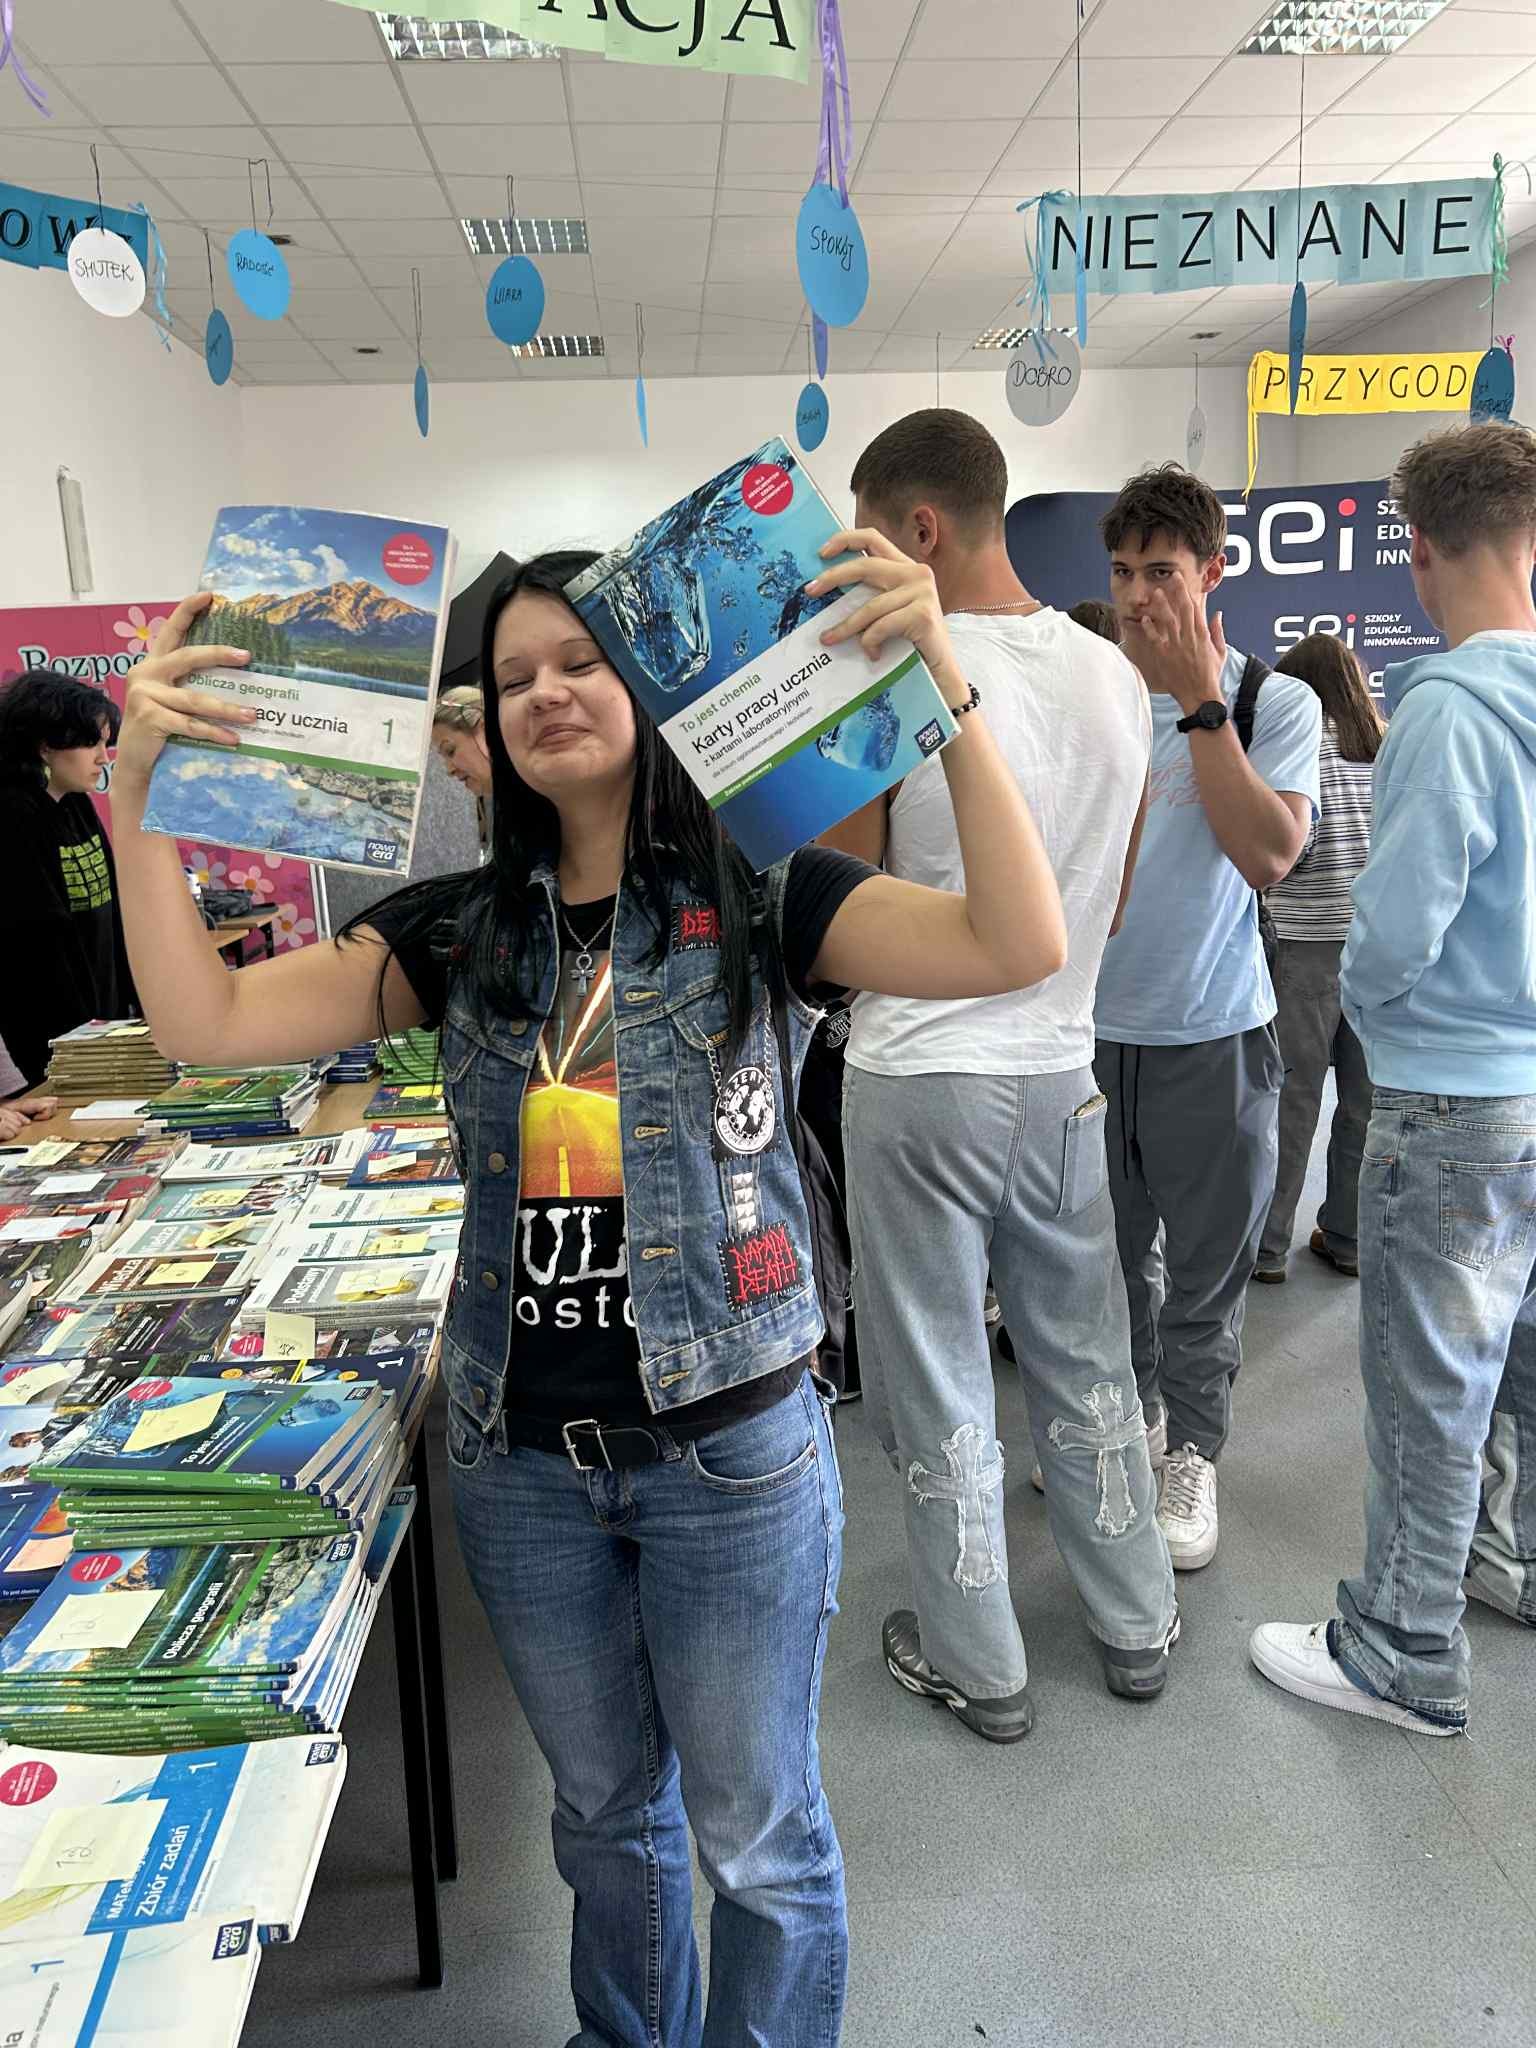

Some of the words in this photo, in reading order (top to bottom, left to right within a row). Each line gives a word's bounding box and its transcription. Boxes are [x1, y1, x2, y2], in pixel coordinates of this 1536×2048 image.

[1052, 196, 1472, 270] NIEZNANE
[1009, 360, 1071, 388] DOBRO
[1274, 613, 1356, 652] sei
[1364, 614, 1402, 624] SZKOŁY
[1364, 626, 1412, 635] EDUKACJI
[1363, 637, 1440, 647] INNOWACYJNEJ
[20, 649, 148, 683] Rozpo
[187, 672, 236, 690] Oblicza
[239, 680, 300, 702] geografii
[680, 720, 695, 734] To
[695, 704, 718, 726] jest
[720, 673, 762, 707] chemia
[691, 720, 734, 754] Karty
[735, 688, 778, 728] pracy
[780, 652, 832, 693] ucznia
[255, 706, 287, 724] acy
[292, 713, 348, 734] ucznia
[383, 718, 394, 744] 1
[710, 738, 743, 765] kartami
[744, 688, 810, 739] laboratoryjnymi
[925, 729, 940, 746] era
[372, 850, 393, 860] era
[284, 1267, 326, 1304] Podstawy
[163, 1624, 197, 1659] Oblicza
[194, 1582, 225, 1622] geografii
[188, 1761, 217, 1774] 1
[309, 1743, 321, 1764] nowa
[135, 1880, 167, 1918] Zbiór
[159, 1824, 190, 1871] zadań
[217, 1927, 232, 1957] nowa
[229, 1925, 243, 1950] era
